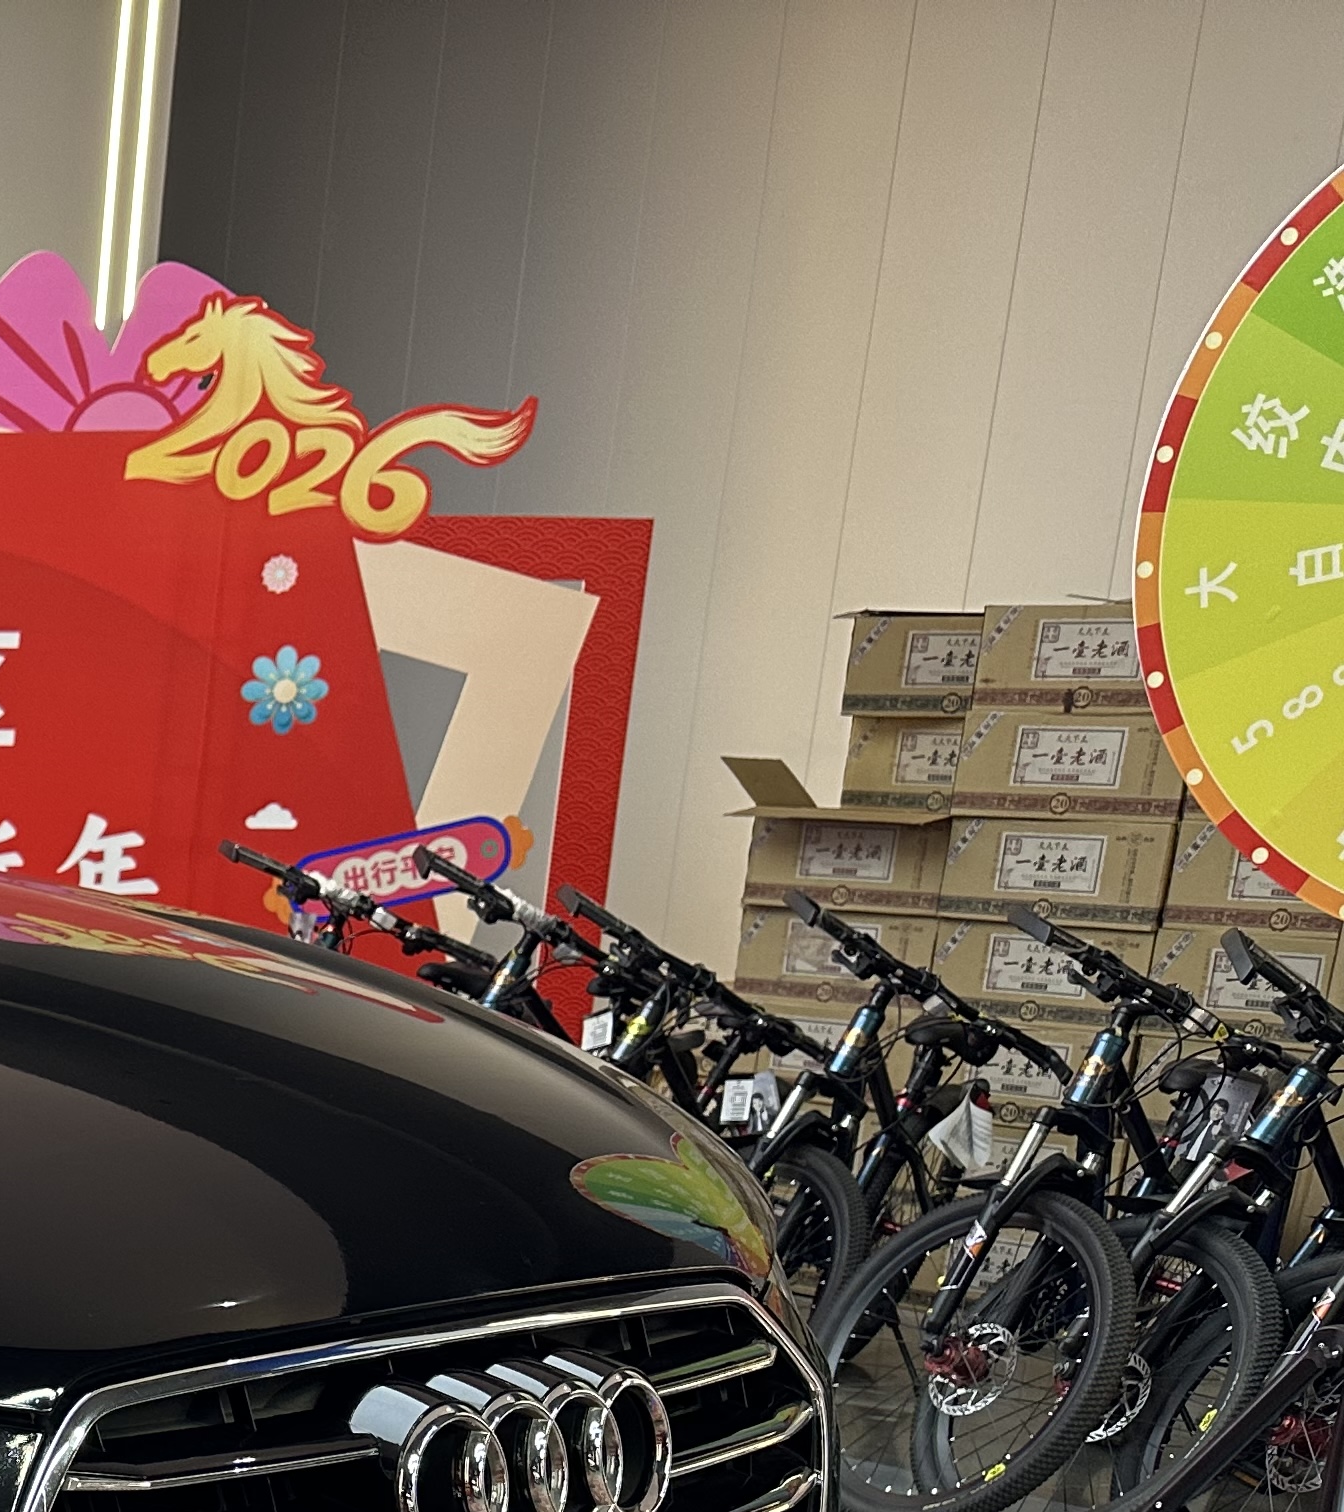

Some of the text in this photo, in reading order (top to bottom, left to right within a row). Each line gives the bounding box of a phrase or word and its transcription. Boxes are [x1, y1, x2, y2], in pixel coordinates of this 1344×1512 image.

[943, 696, 959, 709] 20
[1075, 690, 1091, 703] 20
[928, 795, 943, 808] 20
[1053, 796, 1068, 810] 20
[1272, 912, 1289, 927] 20
[1020, 1004, 1038, 1018] 20
